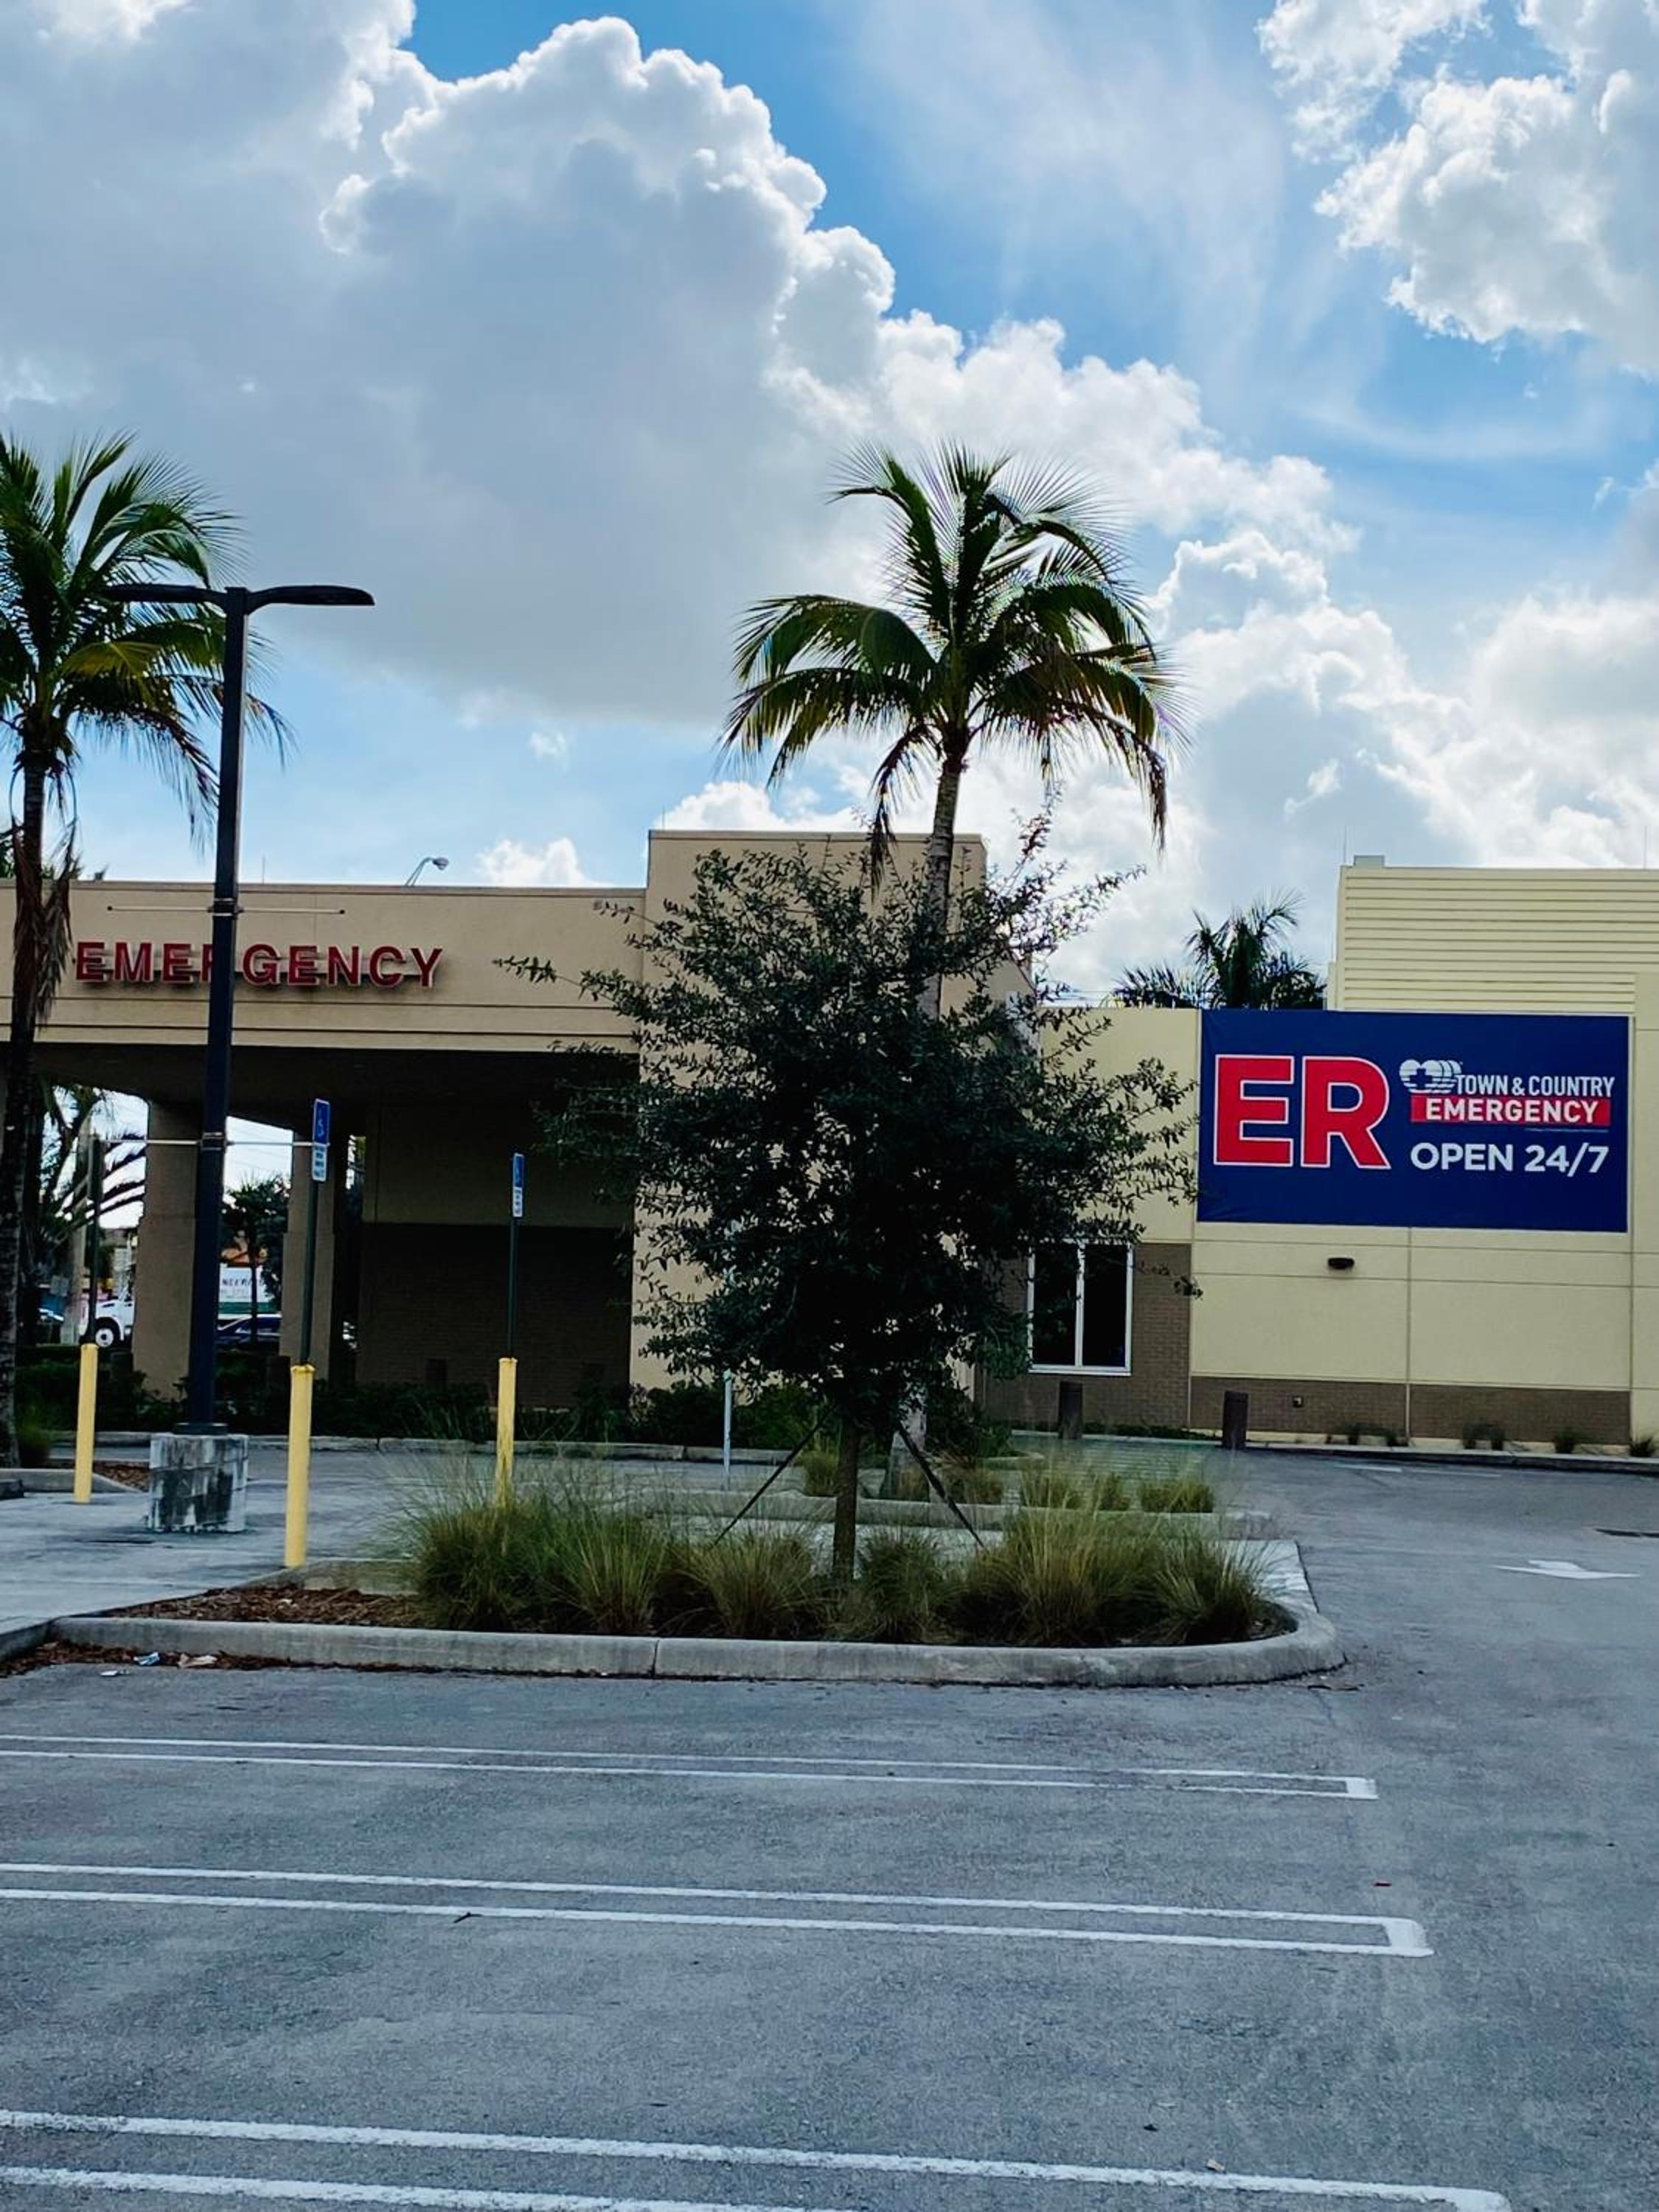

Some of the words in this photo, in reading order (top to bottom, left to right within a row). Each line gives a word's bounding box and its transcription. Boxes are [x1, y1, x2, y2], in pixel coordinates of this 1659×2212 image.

[1454, 1074, 1508, 1096] TOWN
[1512, 1076, 1526, 1096] &
[1528, 1076, 1615, 1098] COUNTRY
[1213, 1054, 1392, 1170] ER
[1426, 1098, 1599, 1123] EMERGENCY
[1411, 1142, 1514, 1171] OPEN
[1524, 1143, 1609, 1178] 24/7
